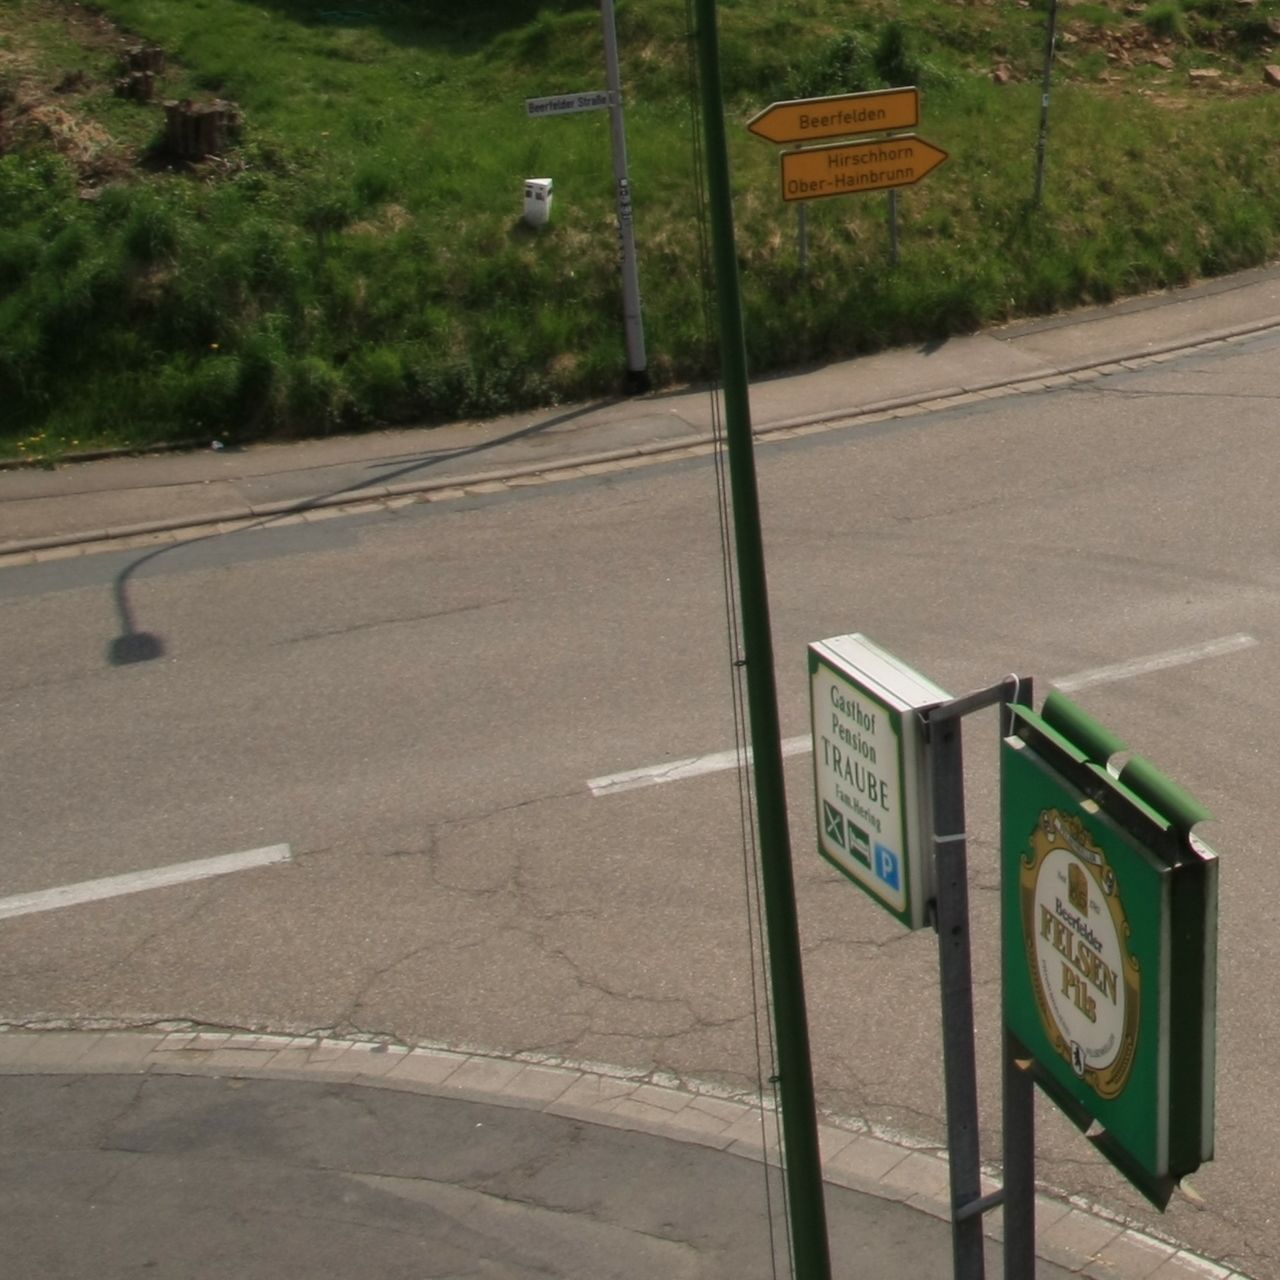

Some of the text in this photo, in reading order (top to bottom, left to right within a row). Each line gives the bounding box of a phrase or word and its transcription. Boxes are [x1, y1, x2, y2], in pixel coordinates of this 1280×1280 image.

[799, 107, 886, 130] Beerfelden
[787, 167, 914, 194] Ober-Hainbrunn
[827, 147, 913, 169] Hirschhorn
[830, 685, 876, 735] Gasthof
[832, 713, 877, 764] Pension
[821, 735, 890, 812] TRAUBE
[881, 850, 893, 879] P
[1055, 897, 1103, 953] Beerfelder
[1040, 904, 1118, 1006] FELSEN
